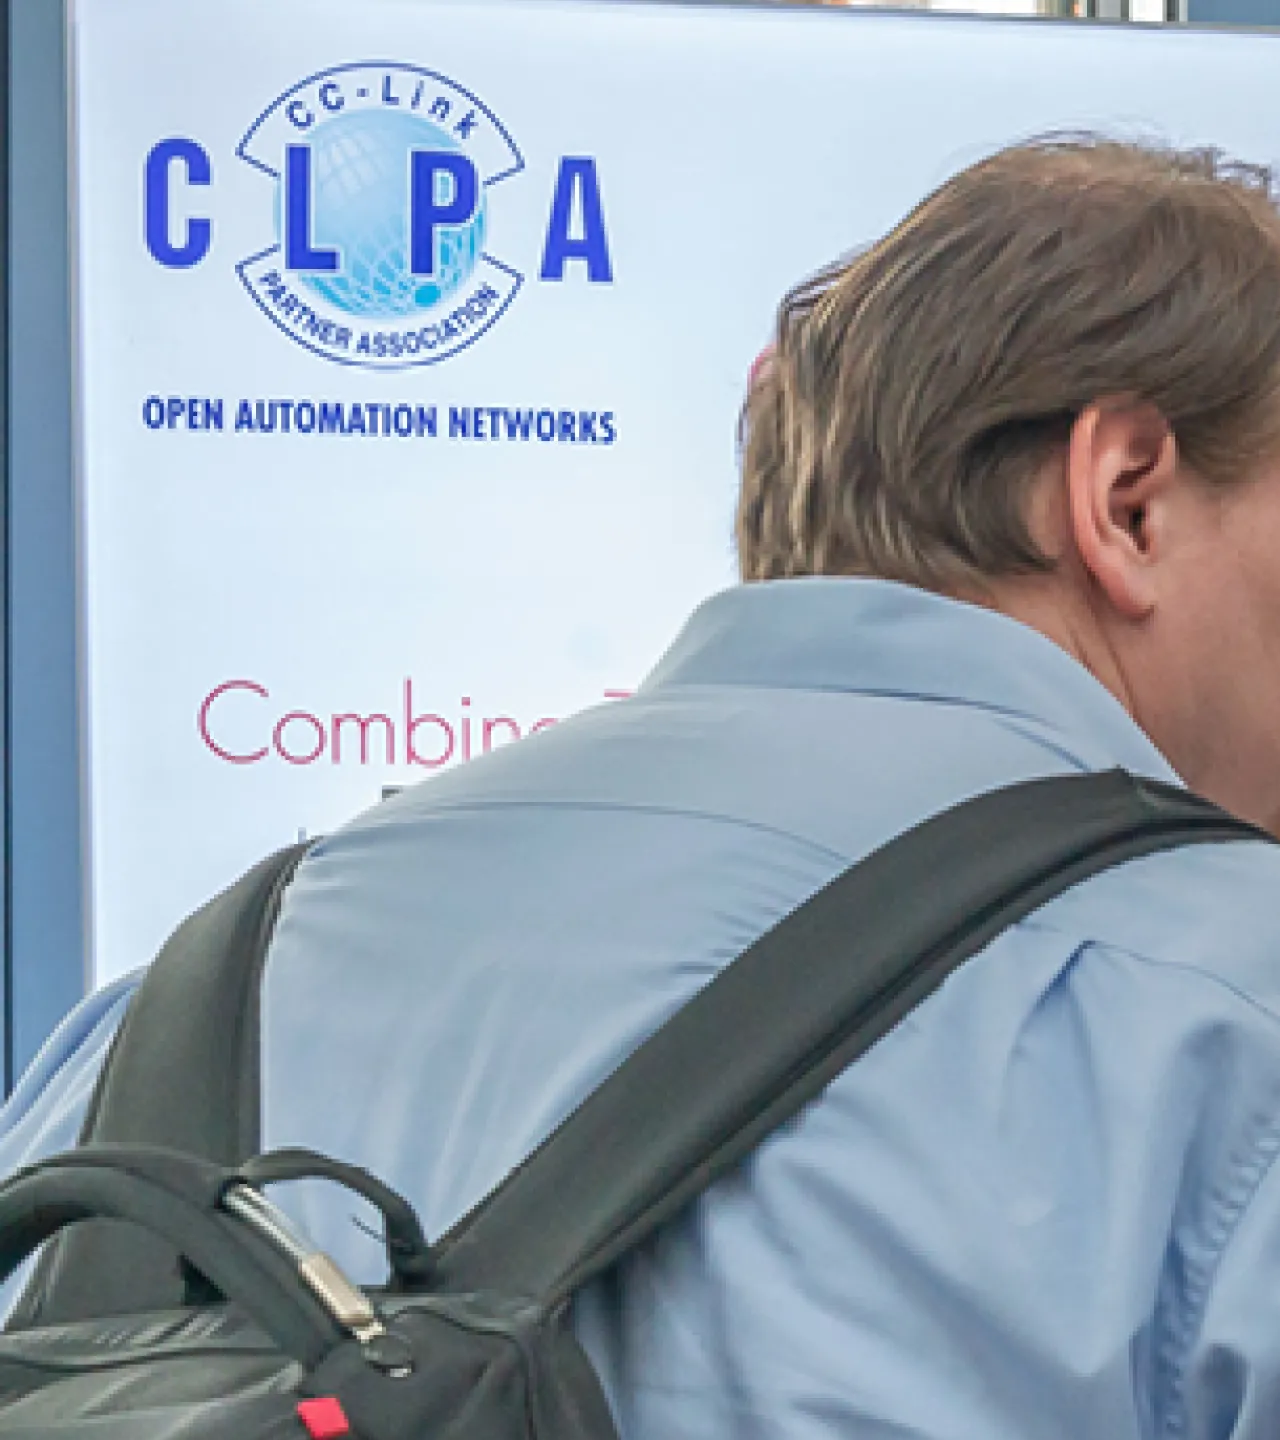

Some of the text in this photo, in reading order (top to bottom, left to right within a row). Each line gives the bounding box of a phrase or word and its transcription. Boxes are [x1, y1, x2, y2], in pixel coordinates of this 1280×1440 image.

[286, 73, 481, 141] CC-Link
[143, 138, 613, 284] CLPA
[259, 272, 502, 358] PARTNER ASSOCIATION
[143, 396, 617, 445] OPEN AUTOMATION NETWORKS
[197, 677, 562, 768] Combin
